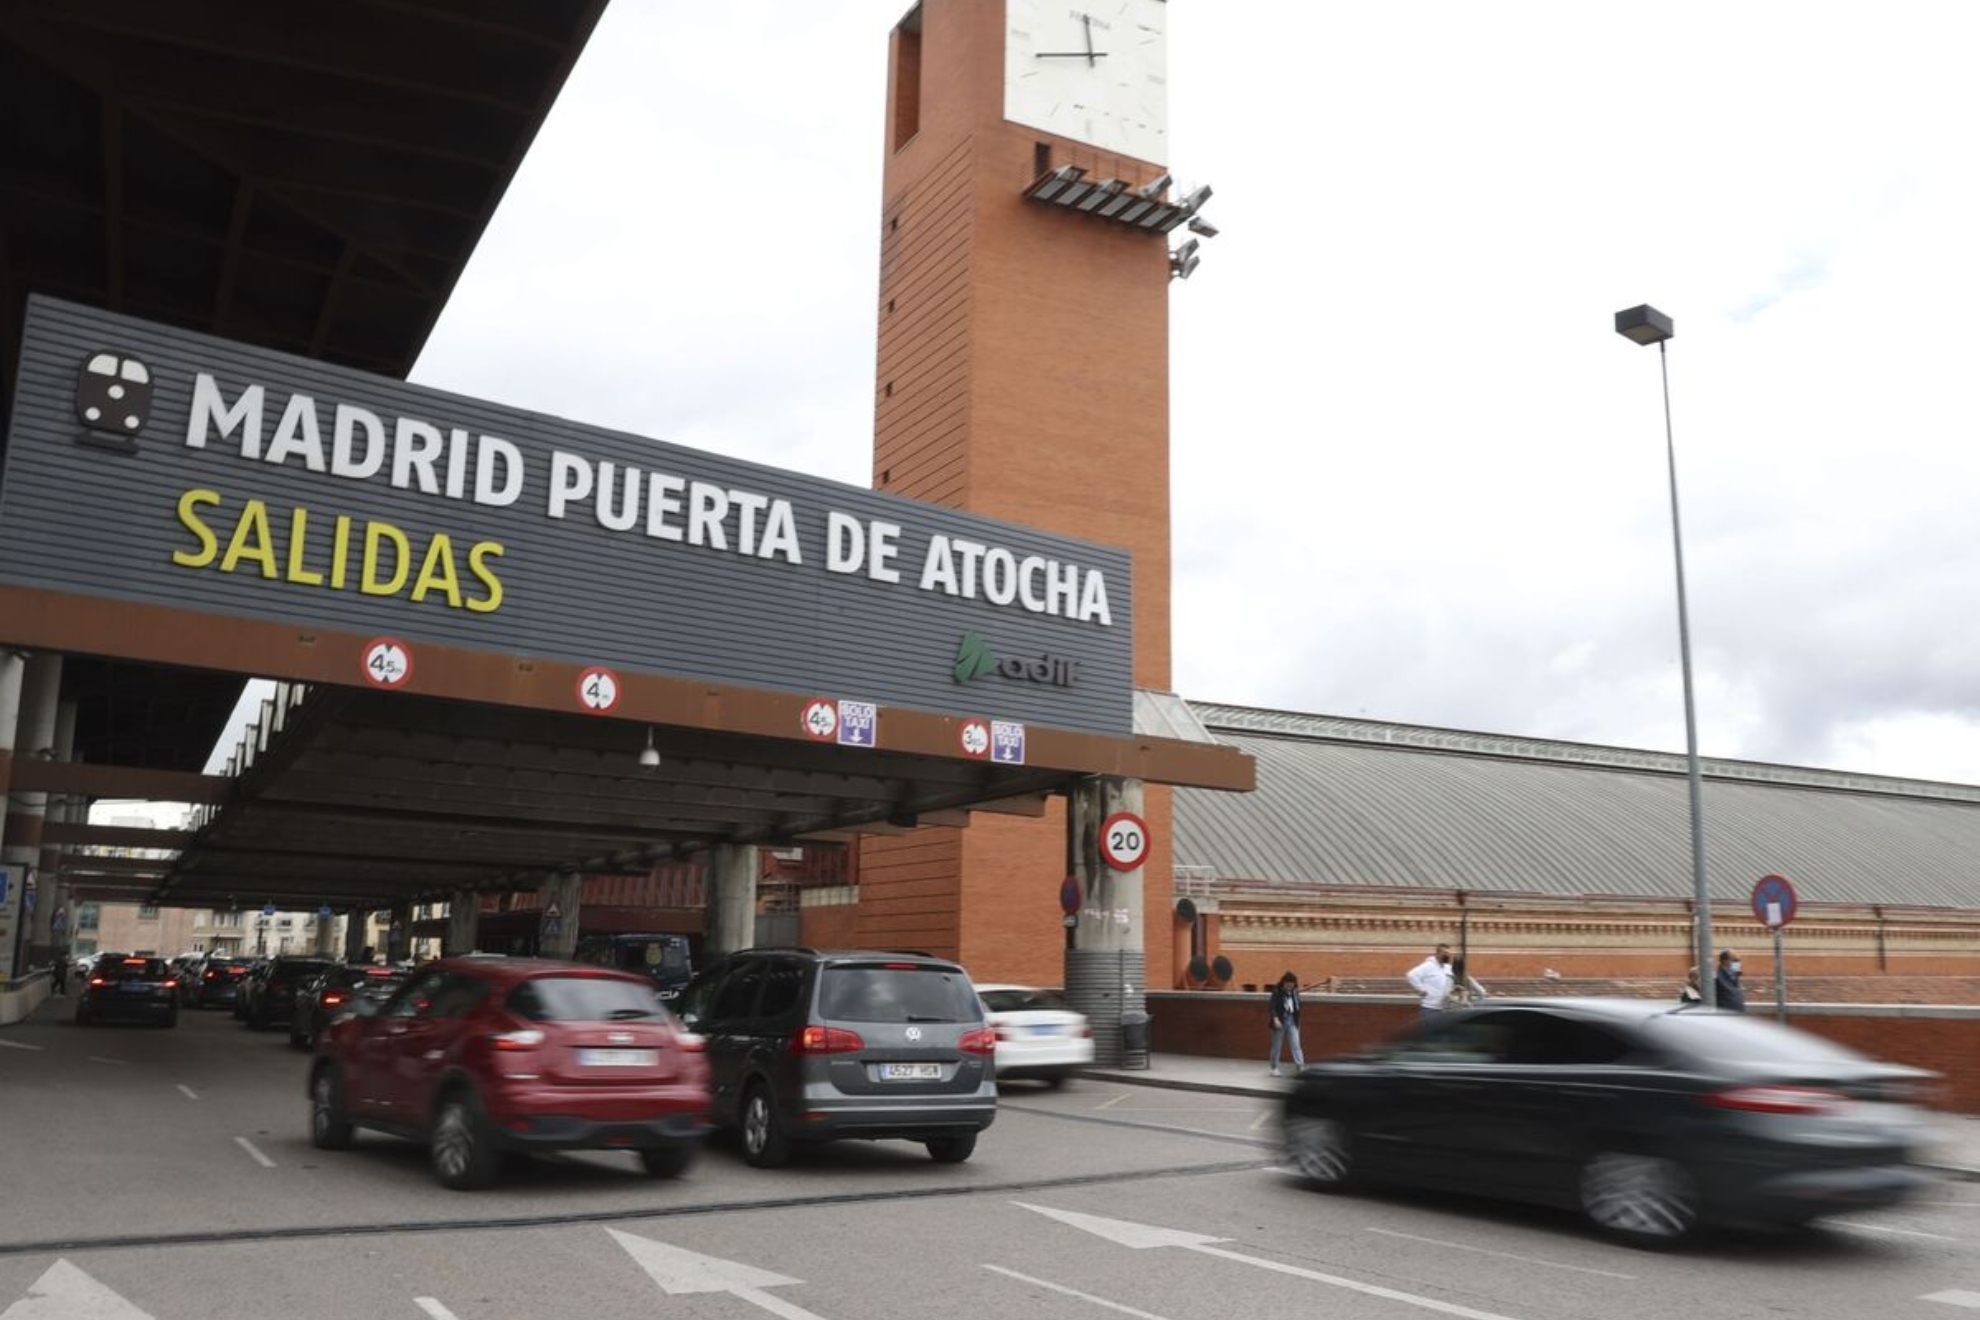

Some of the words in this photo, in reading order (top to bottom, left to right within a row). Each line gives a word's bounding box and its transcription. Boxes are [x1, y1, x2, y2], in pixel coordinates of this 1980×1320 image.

[186, 372, 524, 507] MADRID
[547, 451, 802, 565] PUERTA
[826, 511, 900, 584] DE
[919, 534, 1112, 626] ATOCHA
[173, 489, 504, 613] SALIDAS
[842, 703, 872, 718] SOLO
[845, 715, 870, 729] TAXI
[995, 724, 1021, 738] SOLO
[998, 735, 1019, 748] TAXI
[1111, 832, 1140, 851] 20
